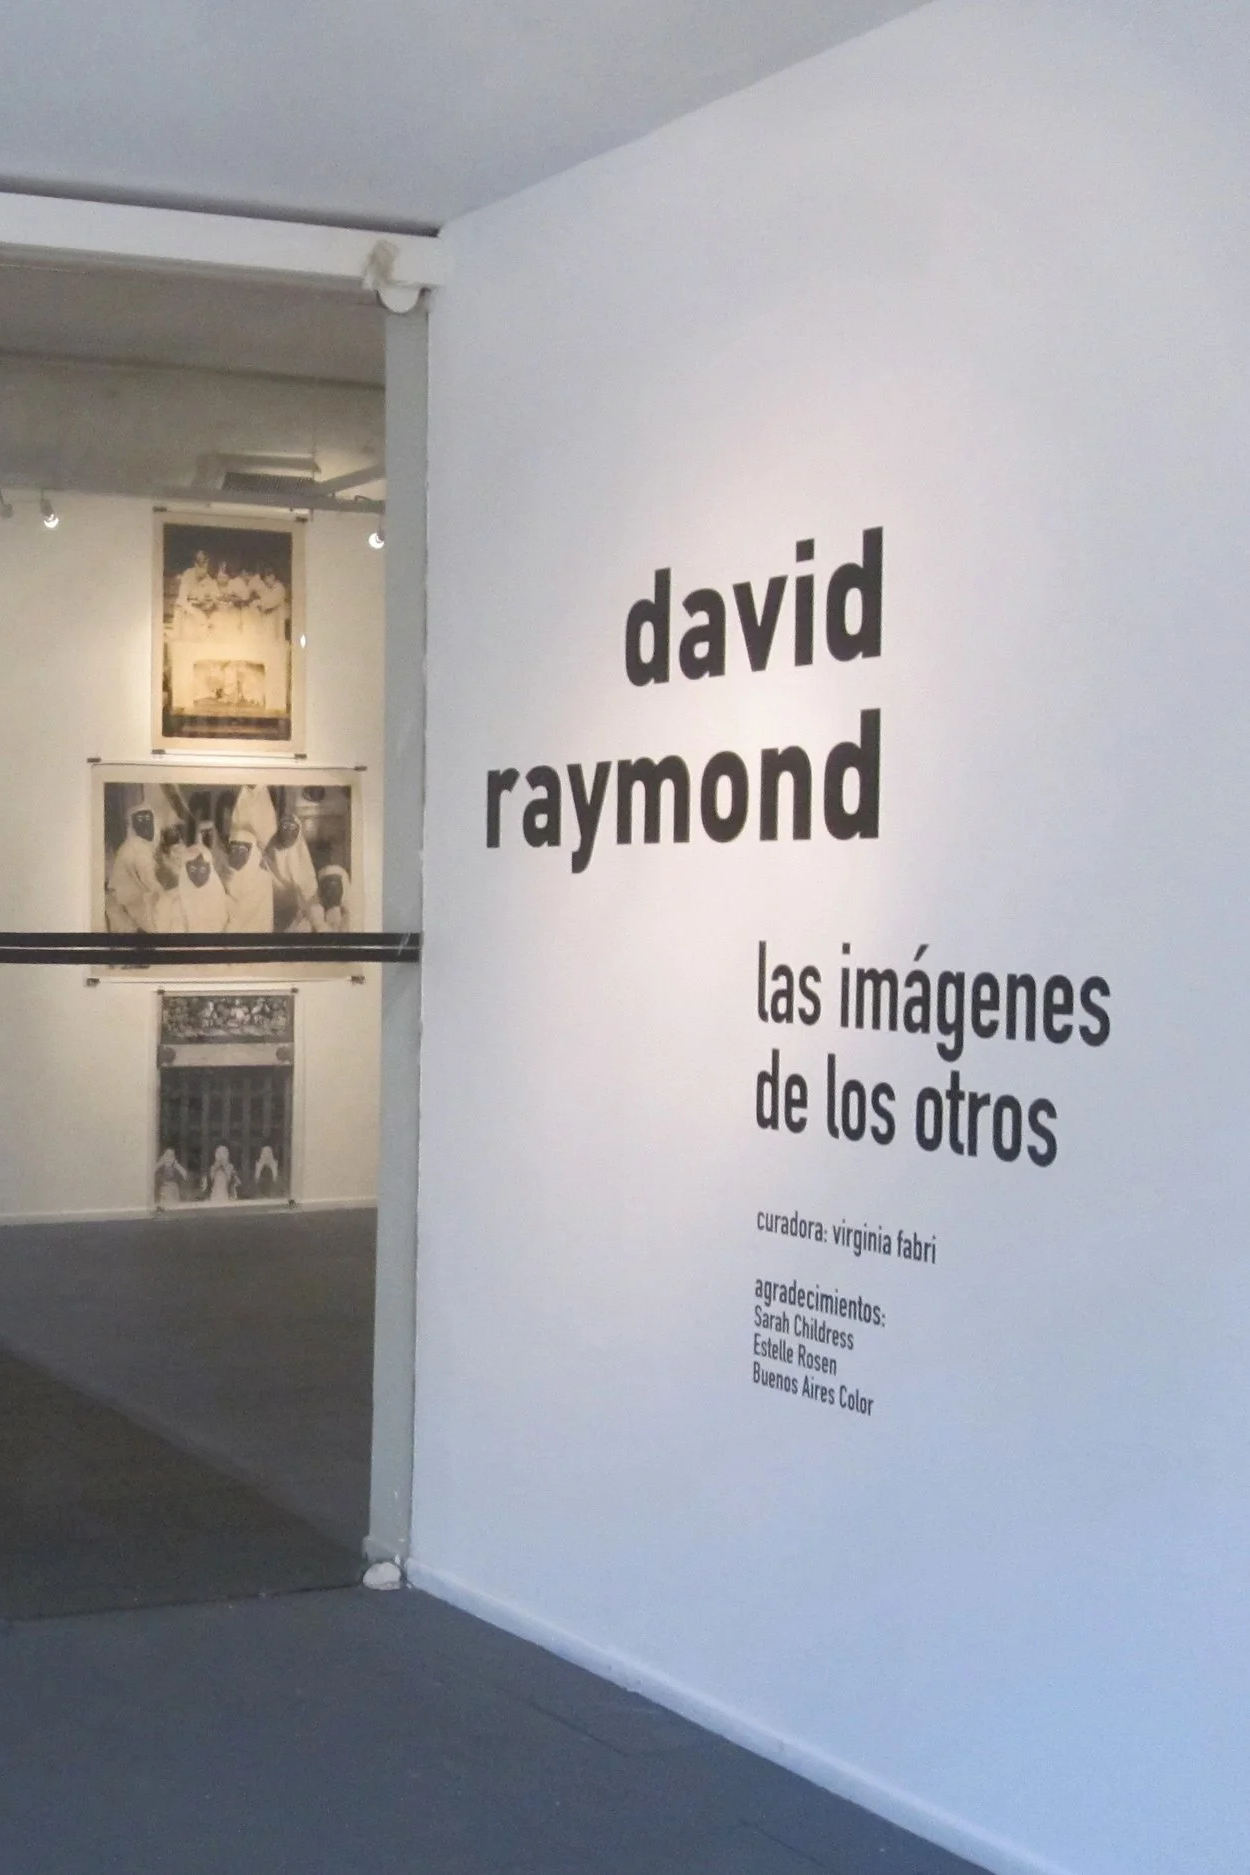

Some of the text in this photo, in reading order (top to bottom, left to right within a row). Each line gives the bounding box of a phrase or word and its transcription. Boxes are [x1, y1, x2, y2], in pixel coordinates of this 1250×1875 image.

[625, 526, 883, 687] david
[486, 708, 881, 874] raymond
[758, 941, 1111, 1063] las imágenes
[756, 1048, 1057, 1168] de los otros
[756, 1210, 937, 1265] curadora: virginia fabri
[754, 1305, 854, 1350] Sarah Childress
[755, 1278, 886, 1327] agradecimientos:
[754, 1333, 837, 1376] Estelle Rosen
[753, 1361, 874, 1416] Buenos Aires Color
